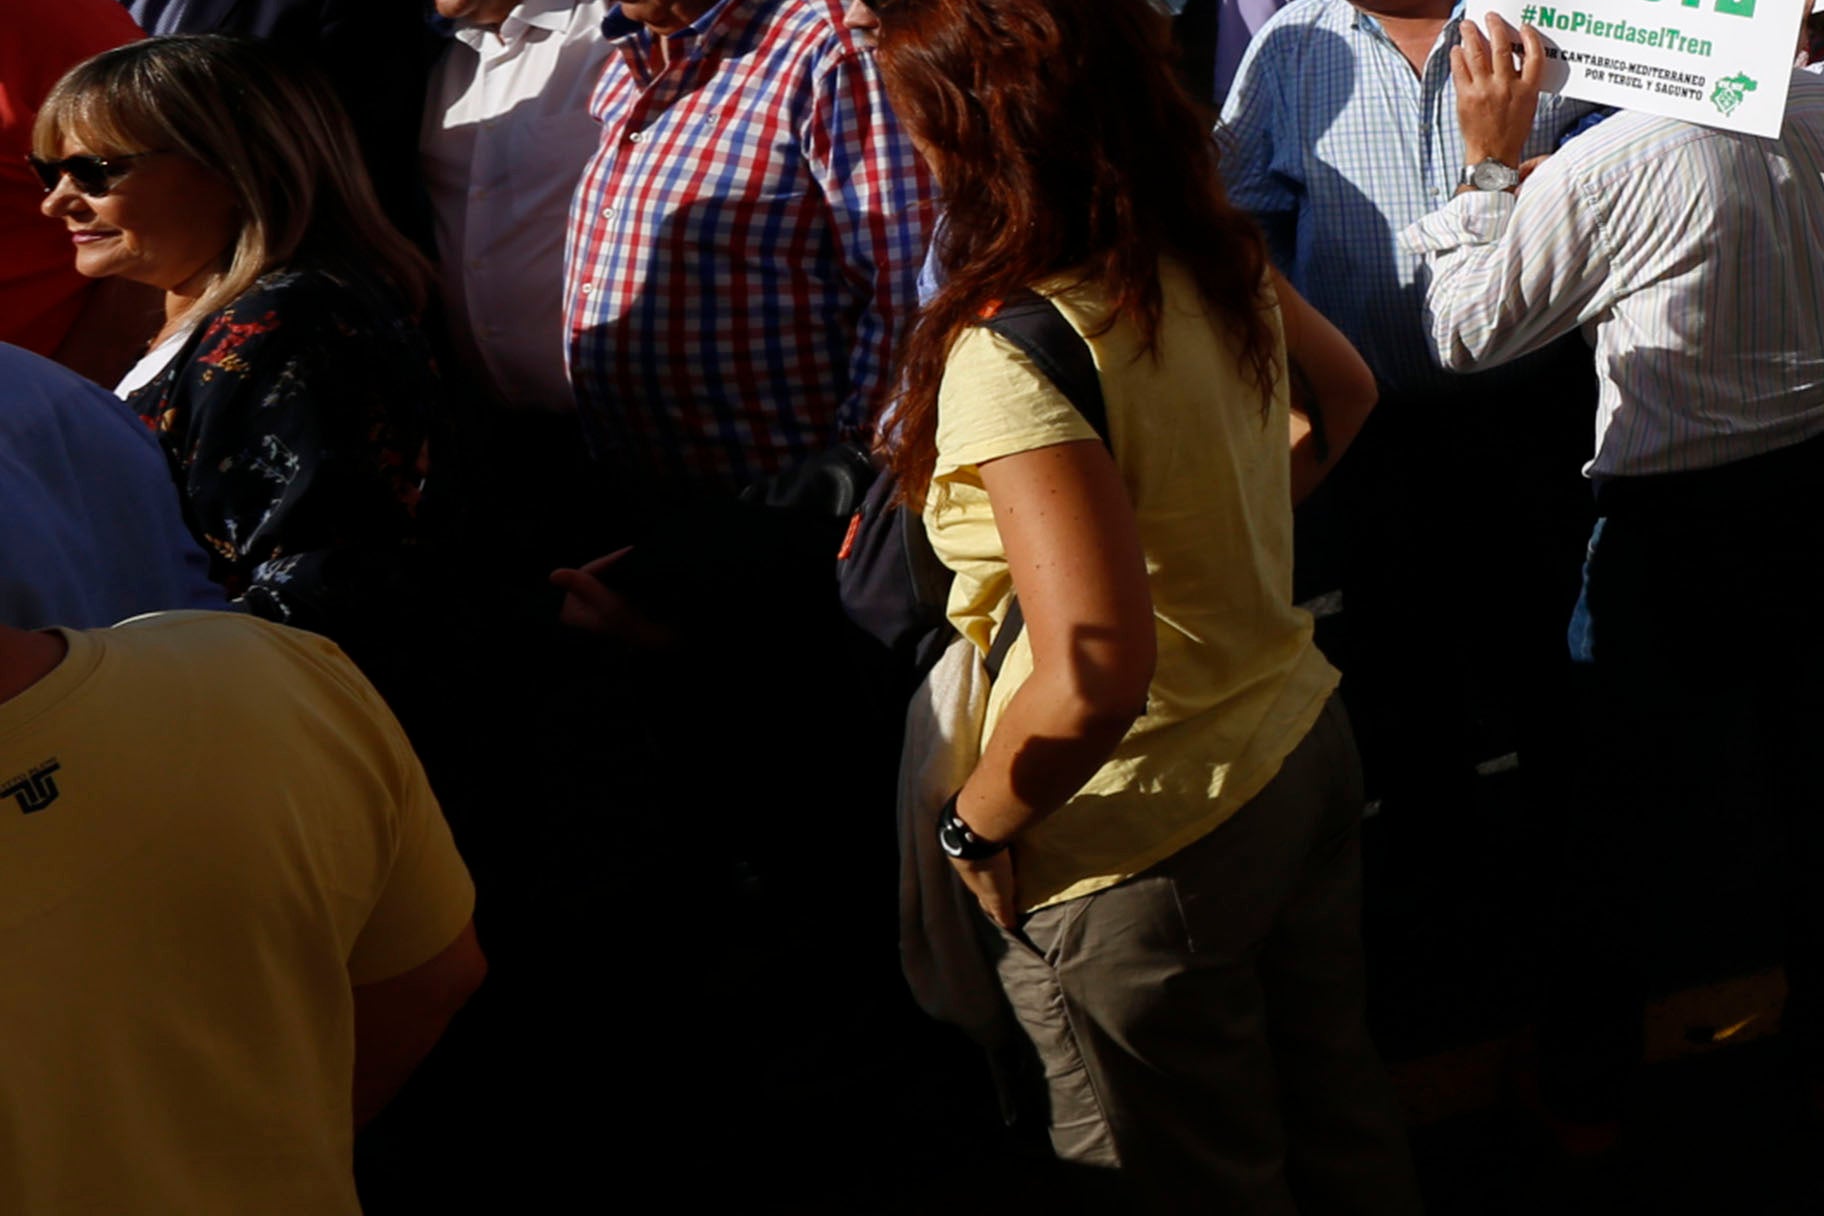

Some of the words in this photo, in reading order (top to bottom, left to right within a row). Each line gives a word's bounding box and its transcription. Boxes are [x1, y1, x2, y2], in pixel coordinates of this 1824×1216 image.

[1521, 4, 1713, 57] #NoPierdaselTren
[1585, 67, 1605, 81] POR
[1608, 71, 1643, 90] TERUEL
[1646, 81, 1653, 91] Y
[1655, 83, 1704, 102] SAGUNTO
